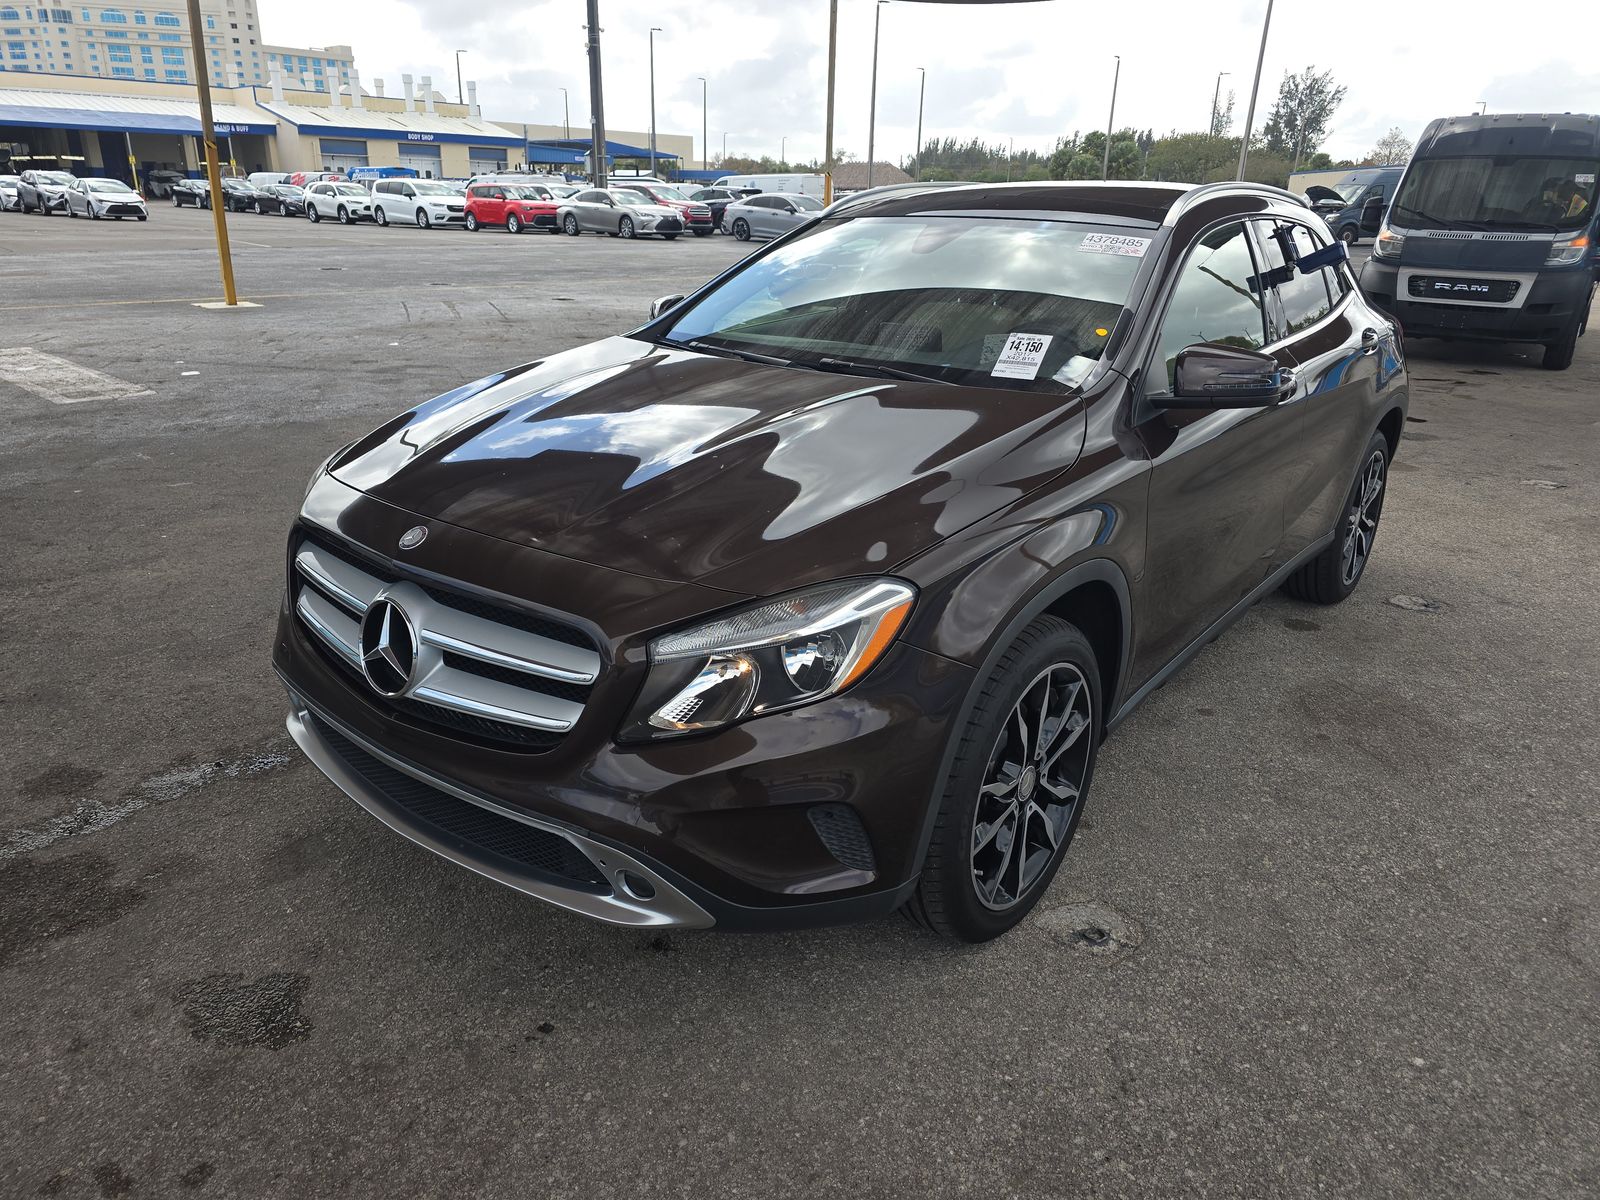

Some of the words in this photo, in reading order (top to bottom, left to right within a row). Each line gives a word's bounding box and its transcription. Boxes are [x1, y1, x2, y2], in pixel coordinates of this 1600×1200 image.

[1086, 235, 1144, 247] 4378485
[1434, 282, 1490, 292] RAM
[1009, 340, 1043, 353] 14:150
